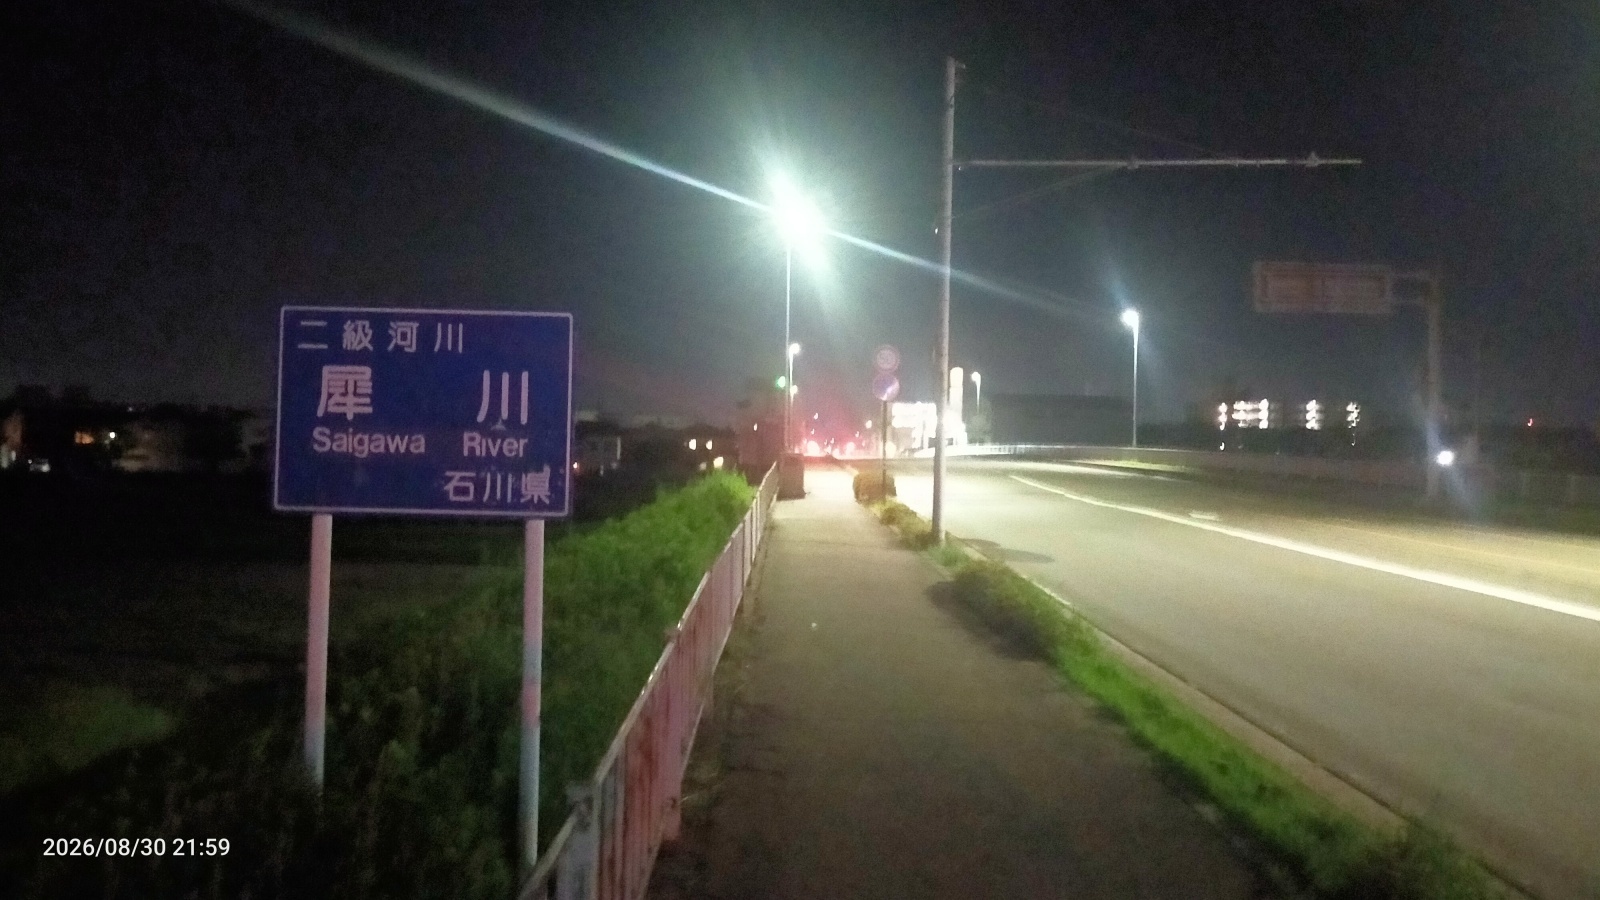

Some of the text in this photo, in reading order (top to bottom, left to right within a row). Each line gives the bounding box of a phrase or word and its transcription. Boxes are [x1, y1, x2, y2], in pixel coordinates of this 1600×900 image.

[298, 320, 463, 353] 二級河川
[312, 427, 528, 458] Saigawa River
[444, 465, 550, 504] 石川県
